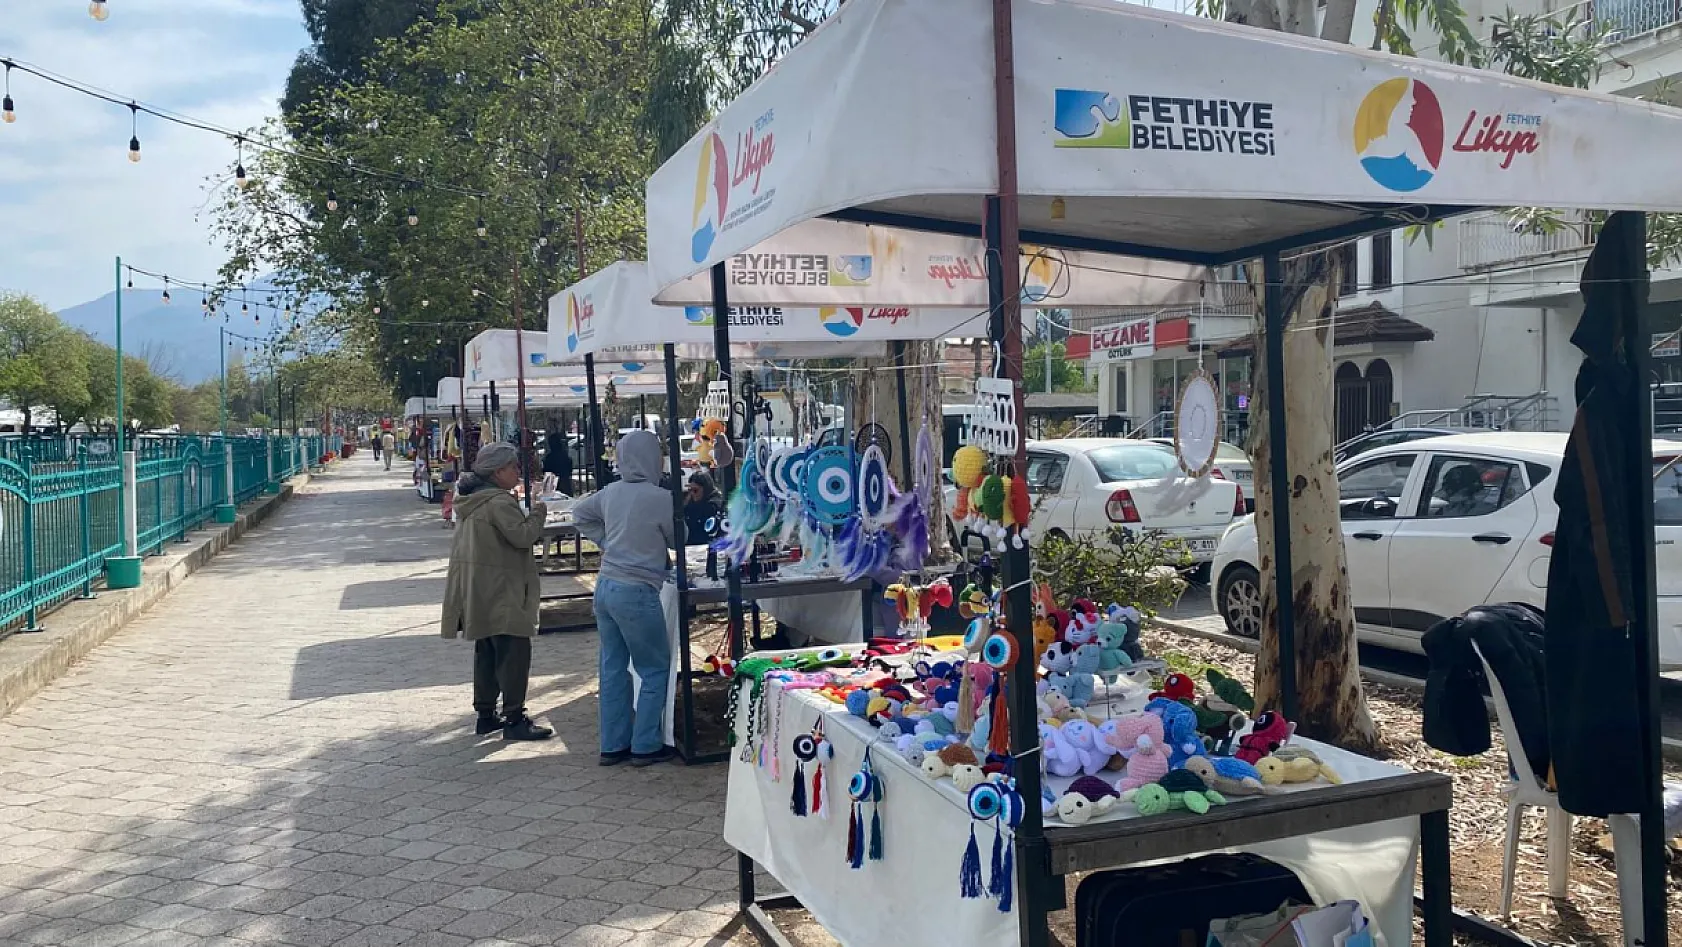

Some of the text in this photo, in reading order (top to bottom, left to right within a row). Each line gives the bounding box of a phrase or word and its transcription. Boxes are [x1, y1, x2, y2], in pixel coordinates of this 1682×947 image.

[732, 127, 775, 195] Likya
[1452, 110, 1540, 169] Likya
[1094, 321, 1150, 350] ECZANE
